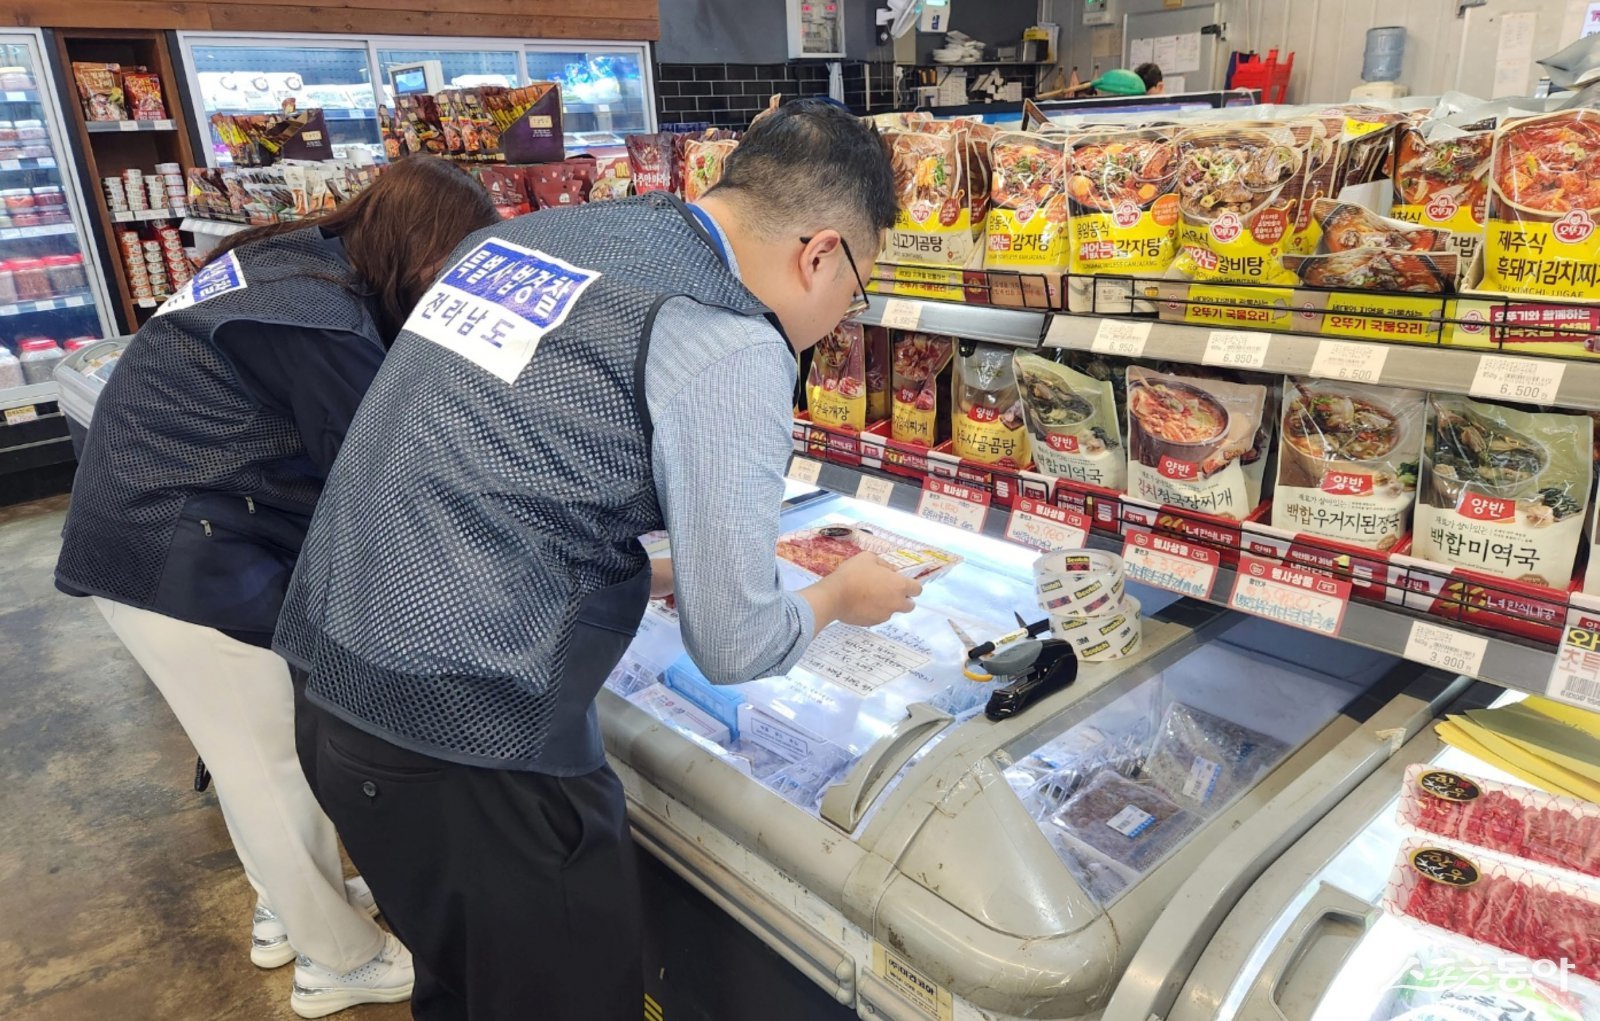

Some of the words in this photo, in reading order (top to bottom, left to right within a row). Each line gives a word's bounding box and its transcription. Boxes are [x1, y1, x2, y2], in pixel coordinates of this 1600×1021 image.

[1429, 206, 1454, 217] 오뚜기
[1558, 223, 1588, 236] 오뚜기
[1115, 237, 1162, 258] 감자탕
[1497, 229, 1548, 255] 제주식
[1218, 255, 1265, 277] 갈비탕
[1497, 256, 1600, 288] 흑돼지김치찌
[455, 248, 576, 320] 특별사법경찰
[420, 290, 517, 350] 전라남도
[1191, 306, 1223, 320] 오뚜기
[1225, 308, 1270, 323] 국물요리
[1330, 316, 1367, 331] 오뚜기
[1370, 319, 1422, 336] 국물요리
[1499, 383, 1541, 399] 6,500
[975, 406, 996, 421] 양반
[1050, 434, 1074, 450] 양반
[1164, 457, 1191, 477] 양반
[942, 483, 970, 499] 행사상품
[1332, 474, 1364, 493] 양반
[1035, 502, 1067, 522] 행사상품
[1470, 497, 1507, 519] 양반
[1152, 536, 1189, 557] 행사상품
[1429, 526, 1541, 572] 백합미역국
[1270, 566, 1315, 590] 행사상품
[1075, 580, 1103, 599] Scotch
[1506, 598, 1557, 622] 한식내공
[1099, 614, 1126, 636] Scotch
[1075, 635, 1090, 646] 3M
[1081, 640, 1110, 657] Scotch
[1428, 650, 1466, 671] 3,900
